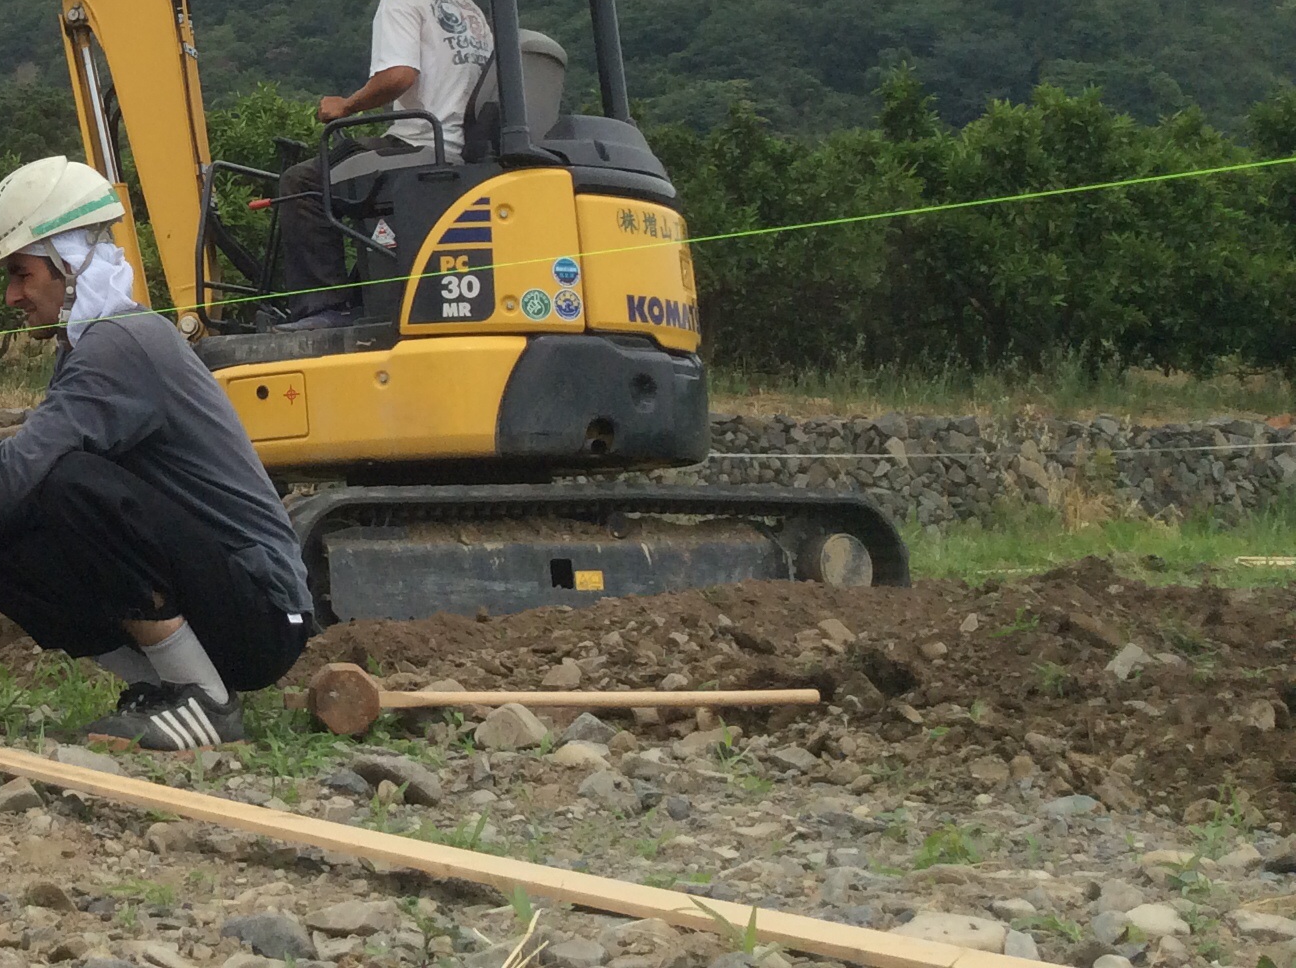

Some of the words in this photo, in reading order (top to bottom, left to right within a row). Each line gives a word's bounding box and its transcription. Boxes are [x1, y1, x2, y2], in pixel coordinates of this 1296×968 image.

[440, 255, 469, 273] PC
[441, 275, 480, 299] 30
[442, 302, 472, 318] MR
